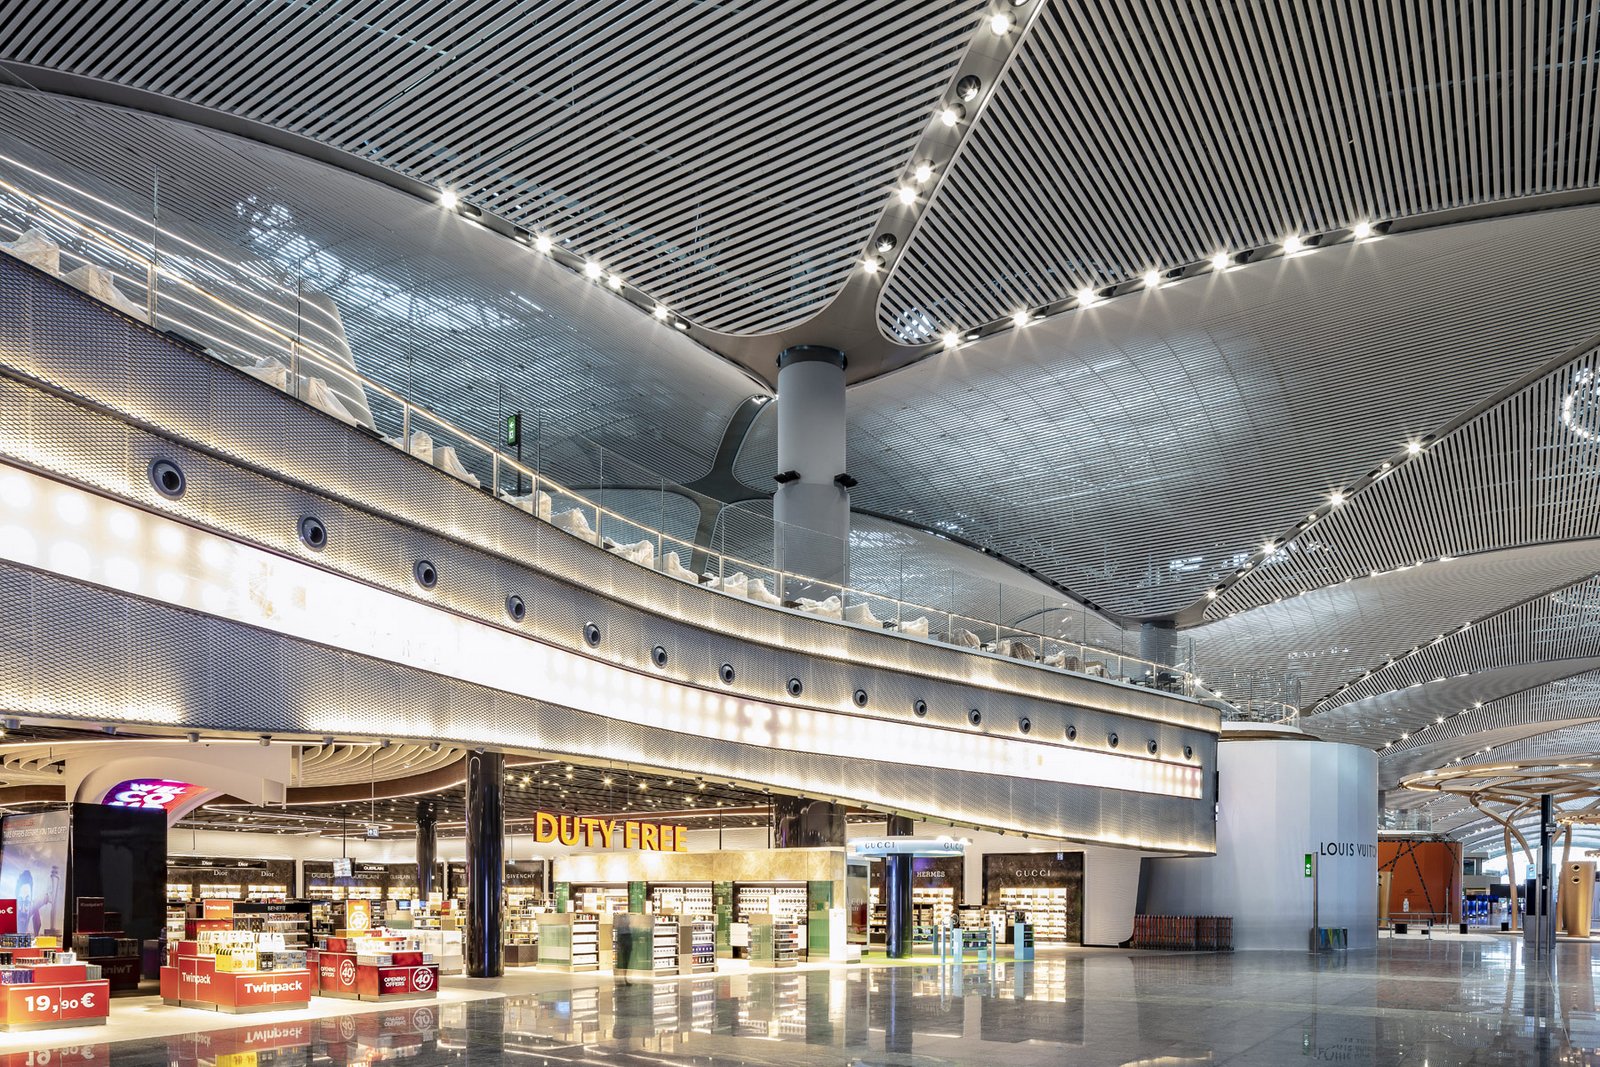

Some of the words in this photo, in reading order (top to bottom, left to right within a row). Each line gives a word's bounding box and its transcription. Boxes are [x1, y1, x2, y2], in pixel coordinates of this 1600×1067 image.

[533, 811, 616, 849] DUTY
[624, 820, 688, 852] FREE
[864, 841, 895, 849] GUCCI
[1320, 842, 1355, 857] LOUIS
[1015, 869, 1051, 877] GUCCI
[181, 972, 211, 985] Twinpack
[244, 980, 303, 994] Twinpack
